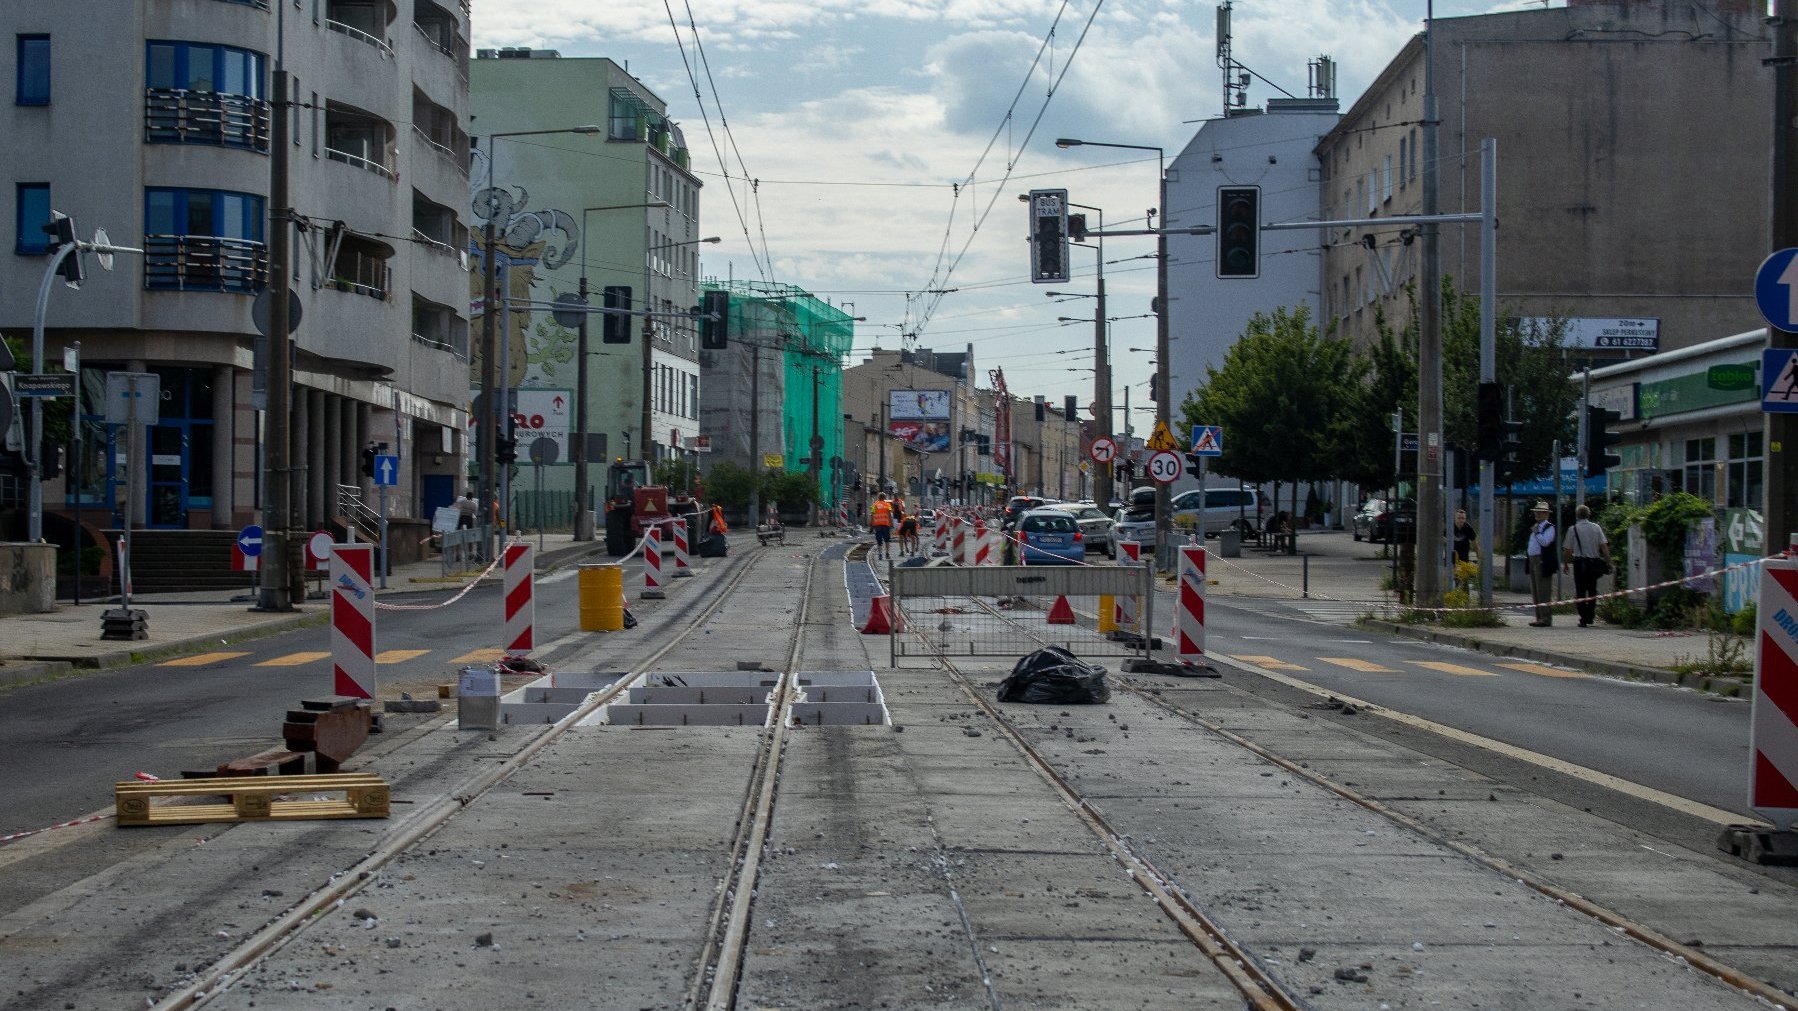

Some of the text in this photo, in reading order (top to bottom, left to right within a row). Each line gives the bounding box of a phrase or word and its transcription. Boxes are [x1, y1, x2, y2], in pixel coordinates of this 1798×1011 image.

[1040, 199, 1056, 207] BUS
[1037, 208, 1060, 216] TRAM
[1611, 338, 1622, 346] 61
[1153, 460, 1177, 476] 30
